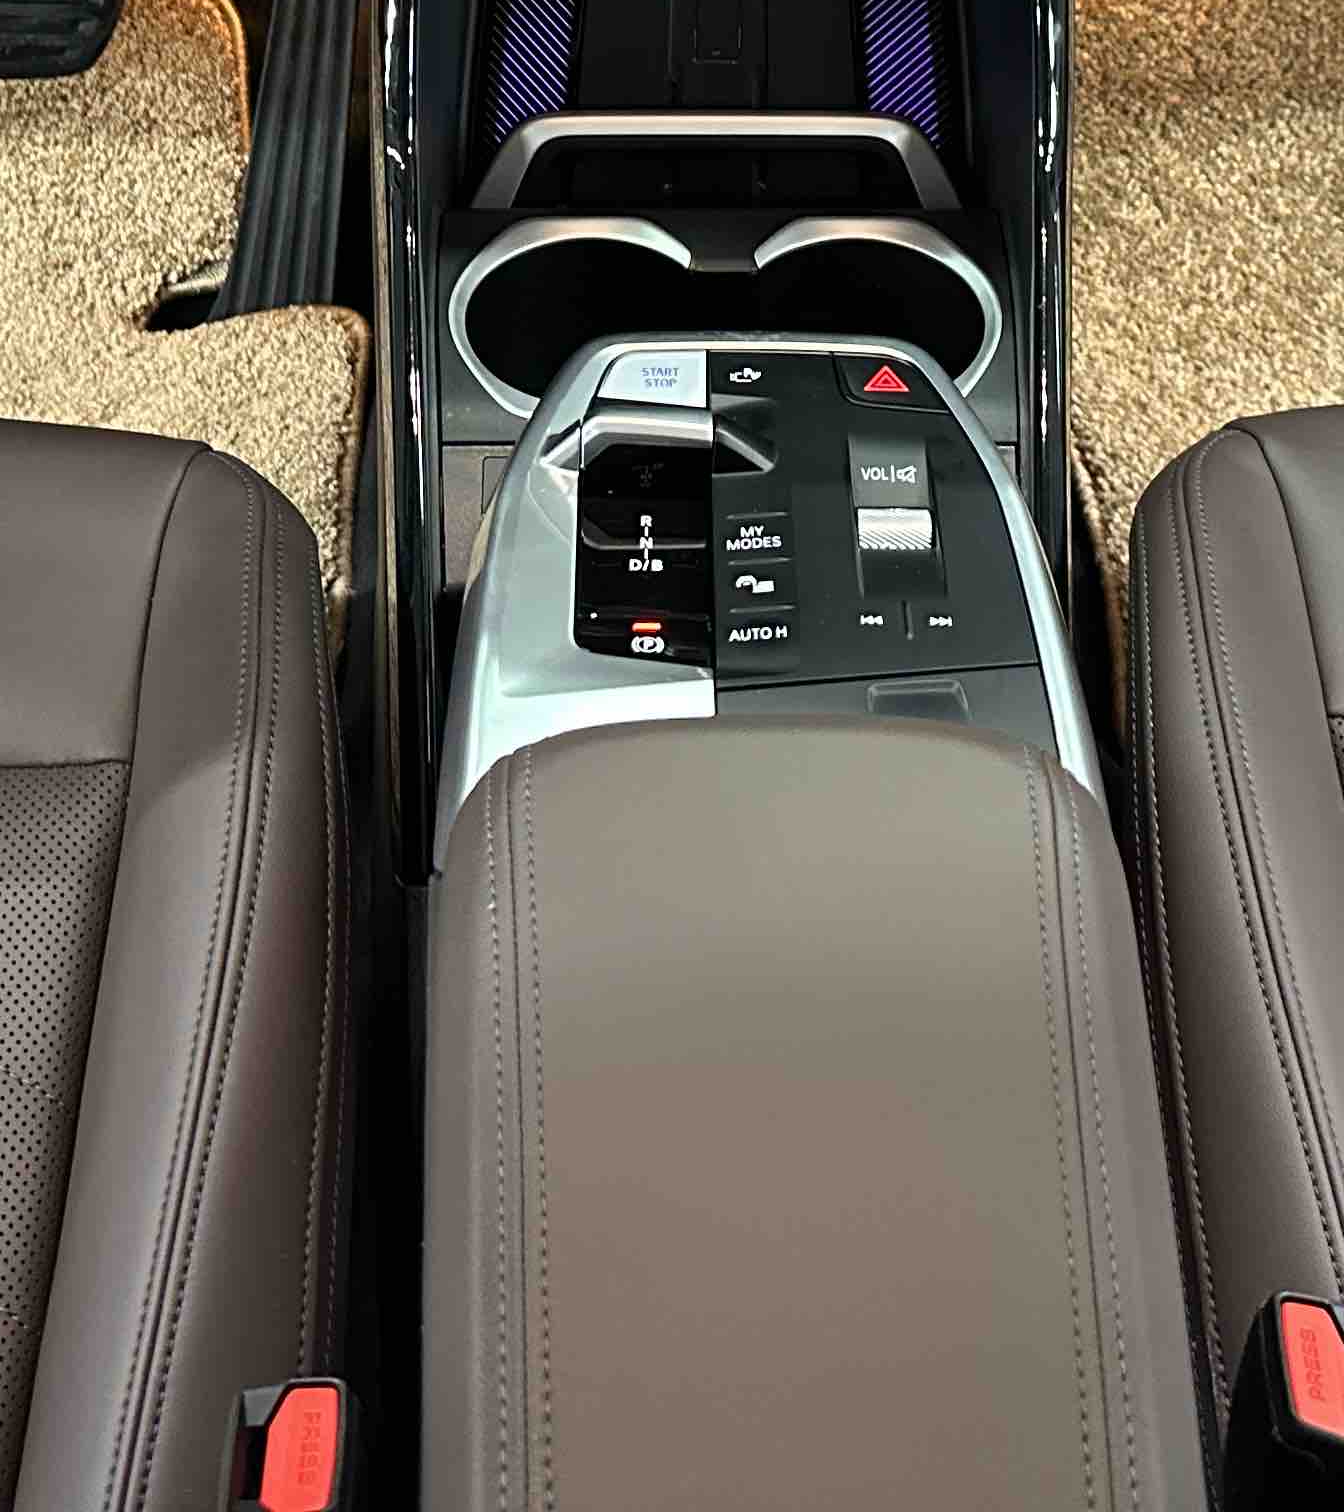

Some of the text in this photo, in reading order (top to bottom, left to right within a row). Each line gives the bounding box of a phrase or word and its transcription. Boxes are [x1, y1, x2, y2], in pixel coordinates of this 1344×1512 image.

[641, 367, 680, 378] START
[644, 378, 678, 389] STOP
[860, 466, 889, 482] VOL
[640, 514, 653, 527] R
[740, 525, 764, 538] MY
[639, 537, 654, 550] N
[726, 535, 782, 551] MODES
[628, 558, 664, 572] D/B
[728, 625, 788, 642] AUTO H
[1299, 1327, 1326, 1402] PRESS
